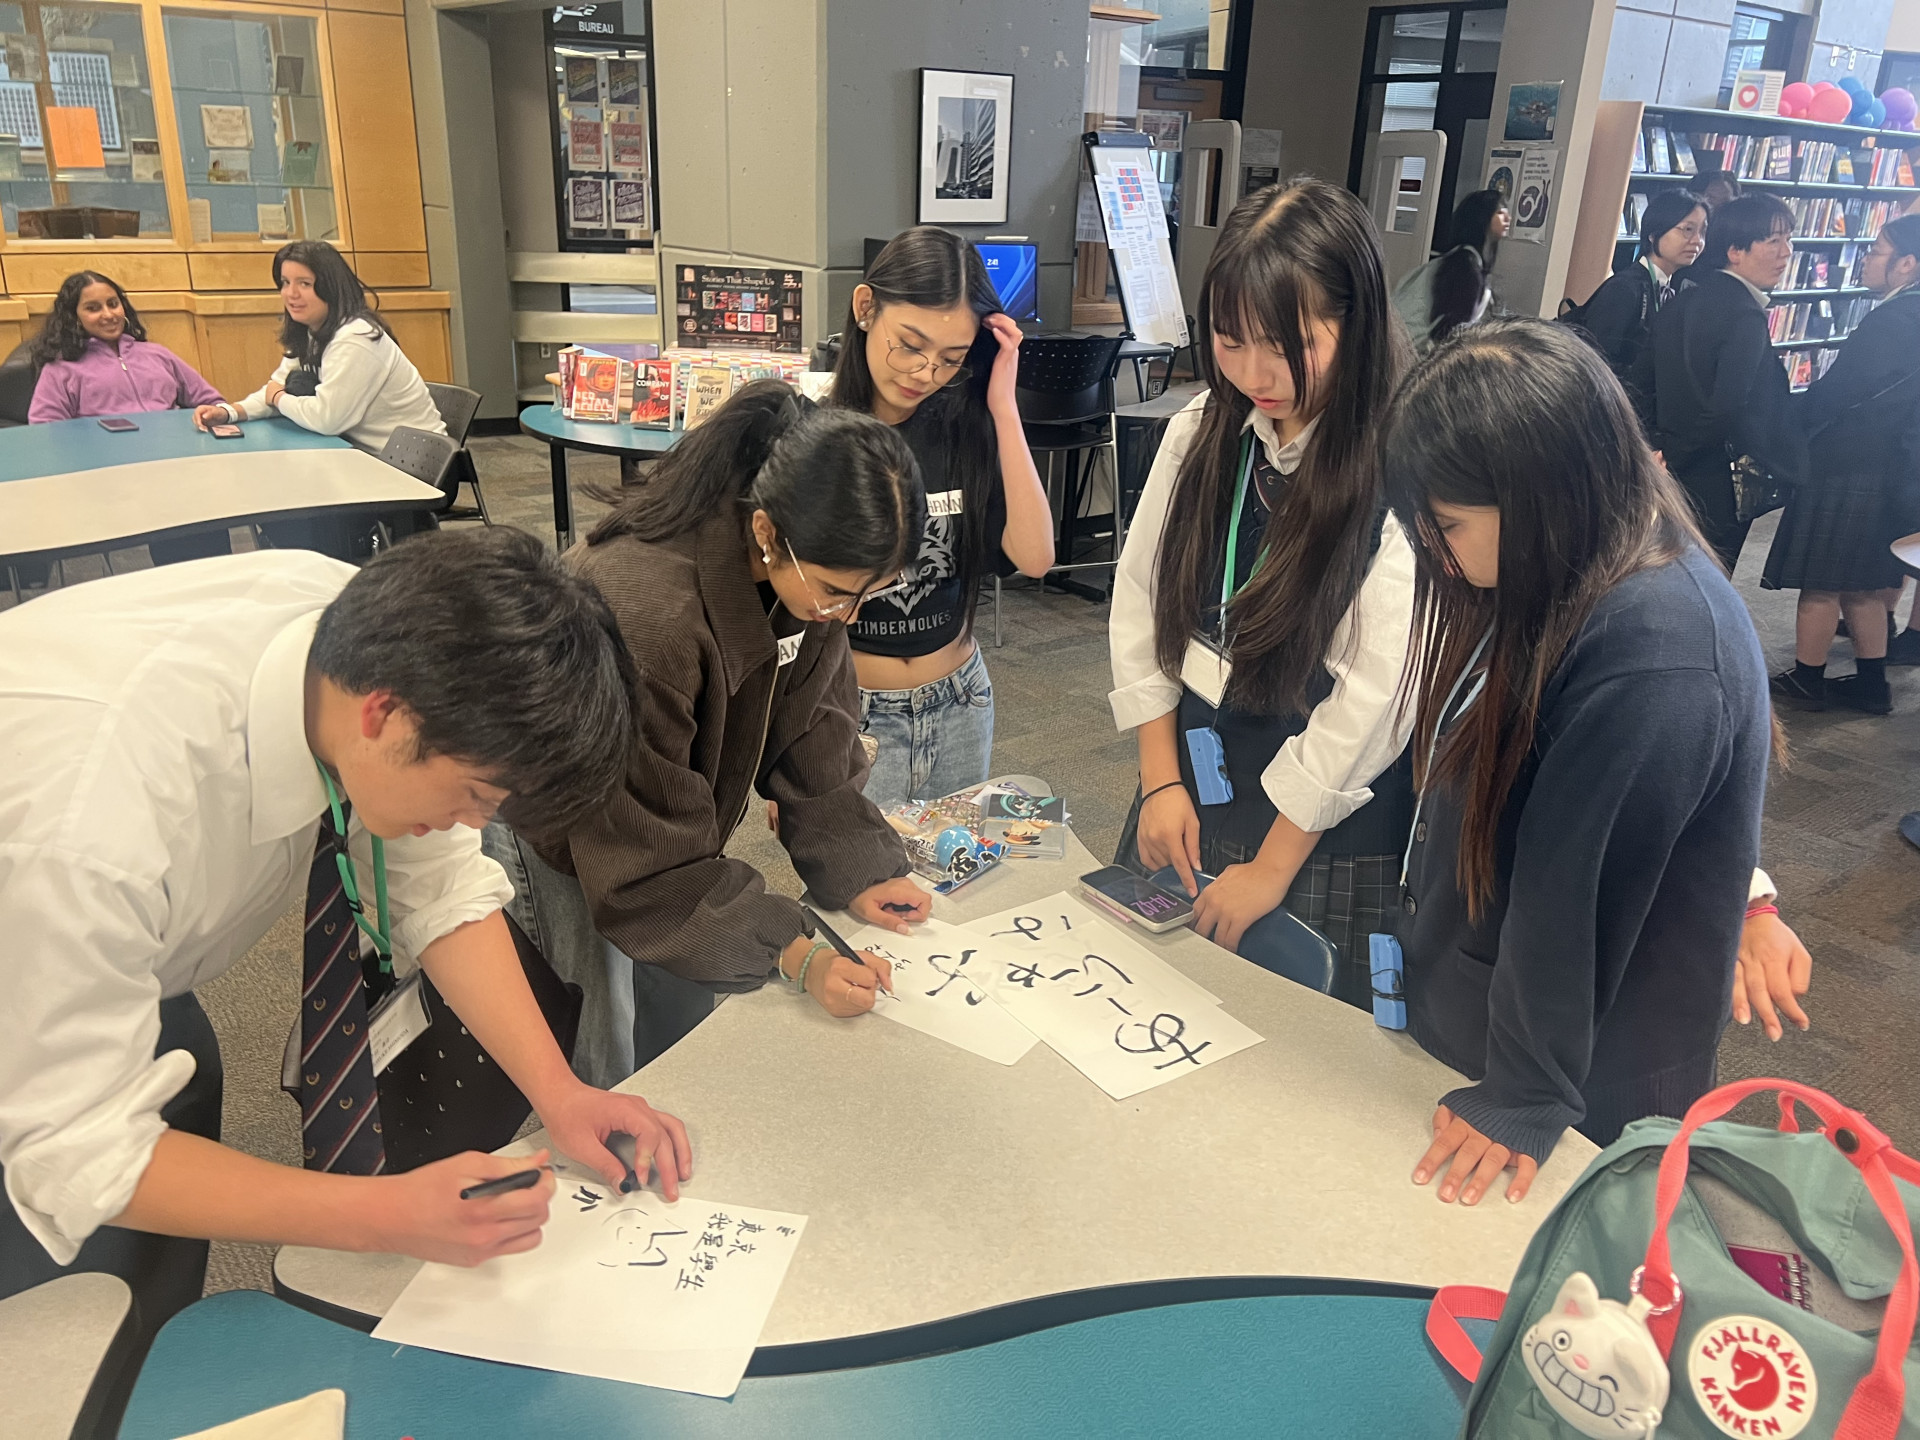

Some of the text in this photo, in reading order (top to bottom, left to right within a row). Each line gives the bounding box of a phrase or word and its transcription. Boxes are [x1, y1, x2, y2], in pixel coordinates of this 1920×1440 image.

[578, 21, 614, 34] BUREAU
[702, 275, 725, 283] Stories
[726, 275, 742, 284] That
[743, 277, 764, 287] Shape
[636, 380, 670, 388] COMPANY
[696, 386, 722, 395] WHEN
[700, 397, 714, 406] WE
[856, 609, 951, 635] TIMBERWOLVES
[1129, 894, 1178, 917] 14:42
